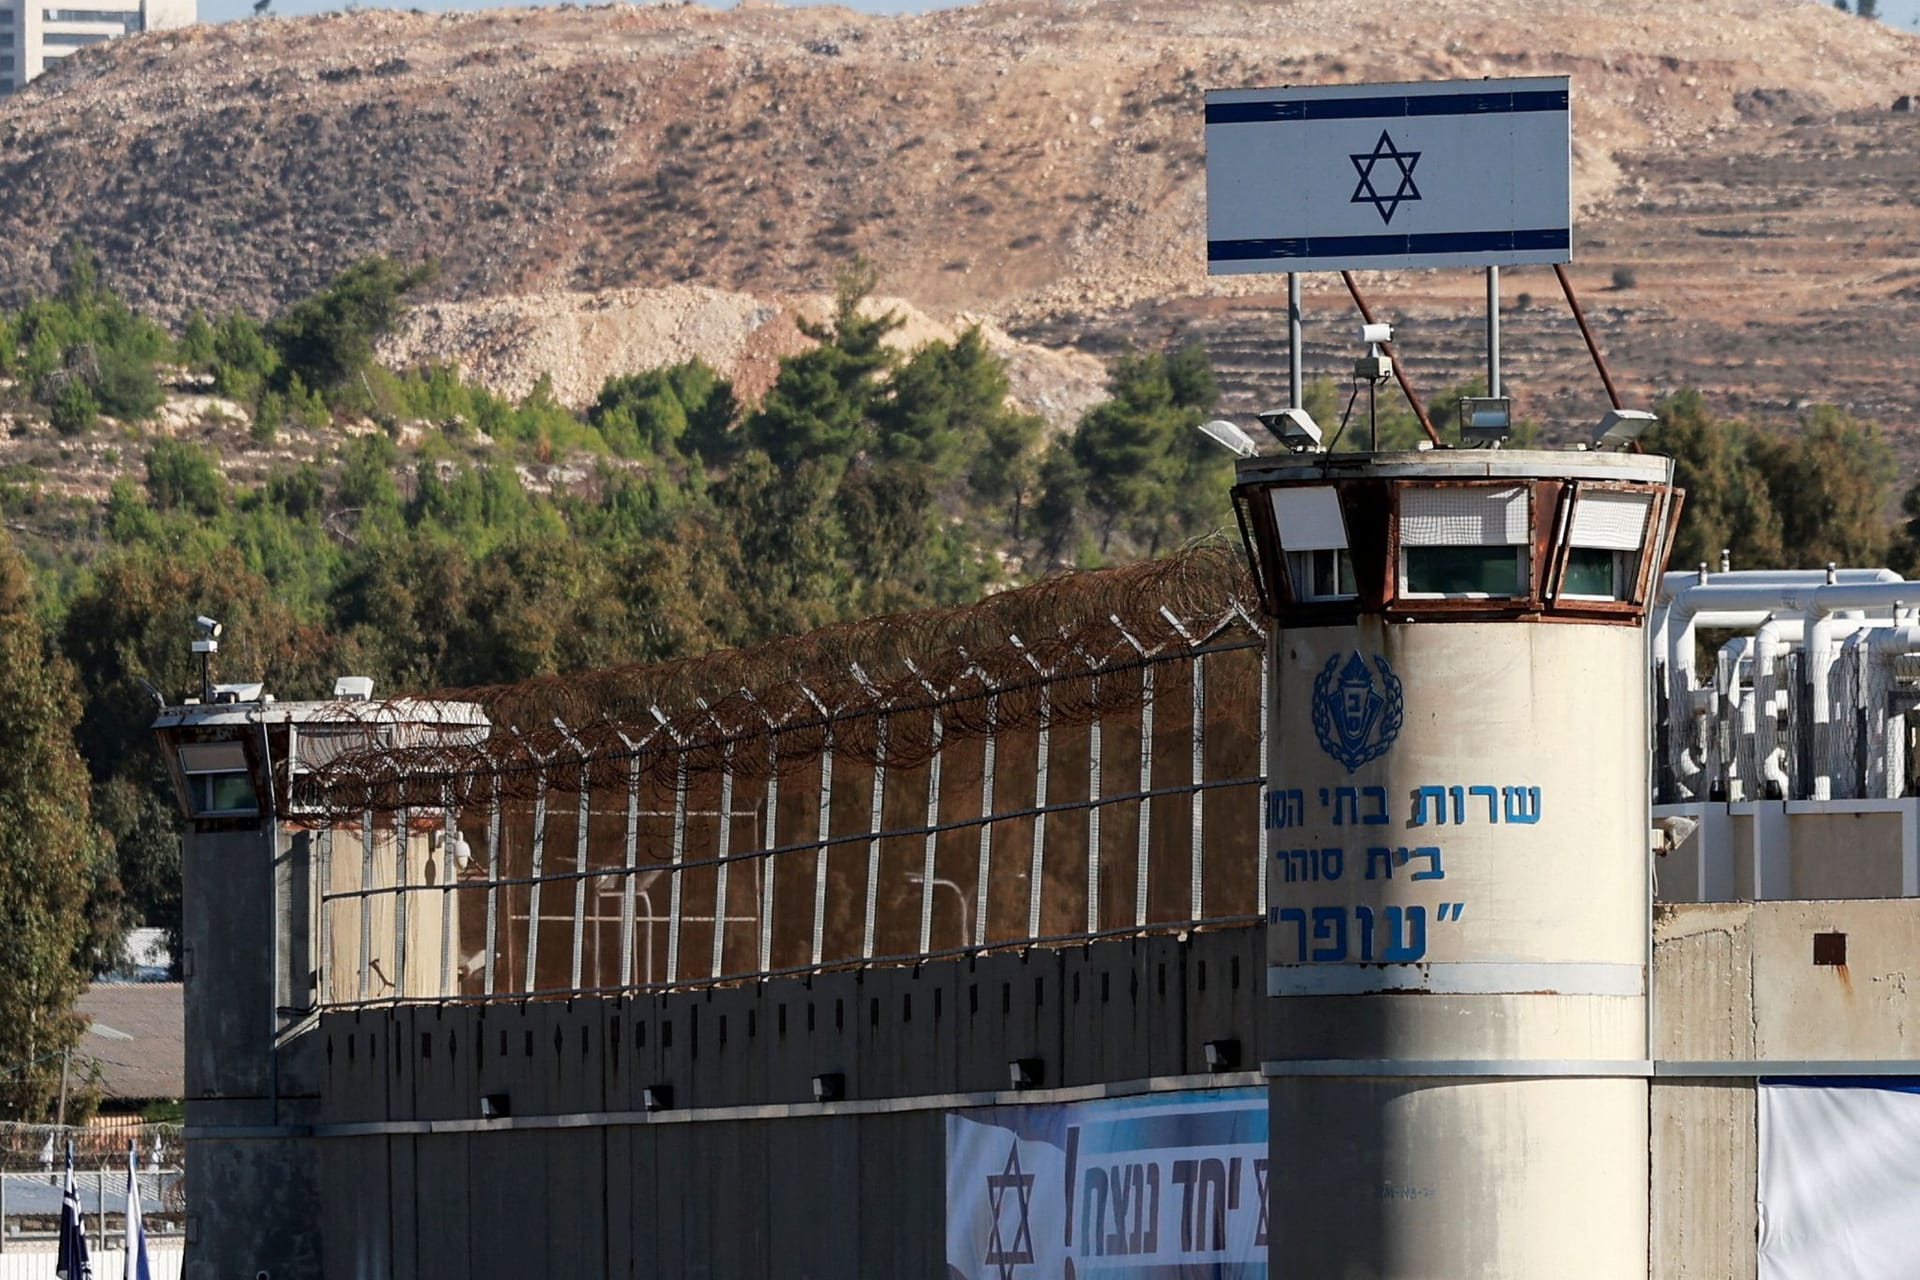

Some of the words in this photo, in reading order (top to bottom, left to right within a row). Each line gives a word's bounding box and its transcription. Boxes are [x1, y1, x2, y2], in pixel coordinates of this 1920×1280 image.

[1319, 786, 1390, 825] בתי
[1416, 785, 1542, 825] שרות
[1276, 848, 1344, 883] סוהר
[1365, 846, 1446, 881] בית
[1171, 1157, 1242, 1252] יחד
